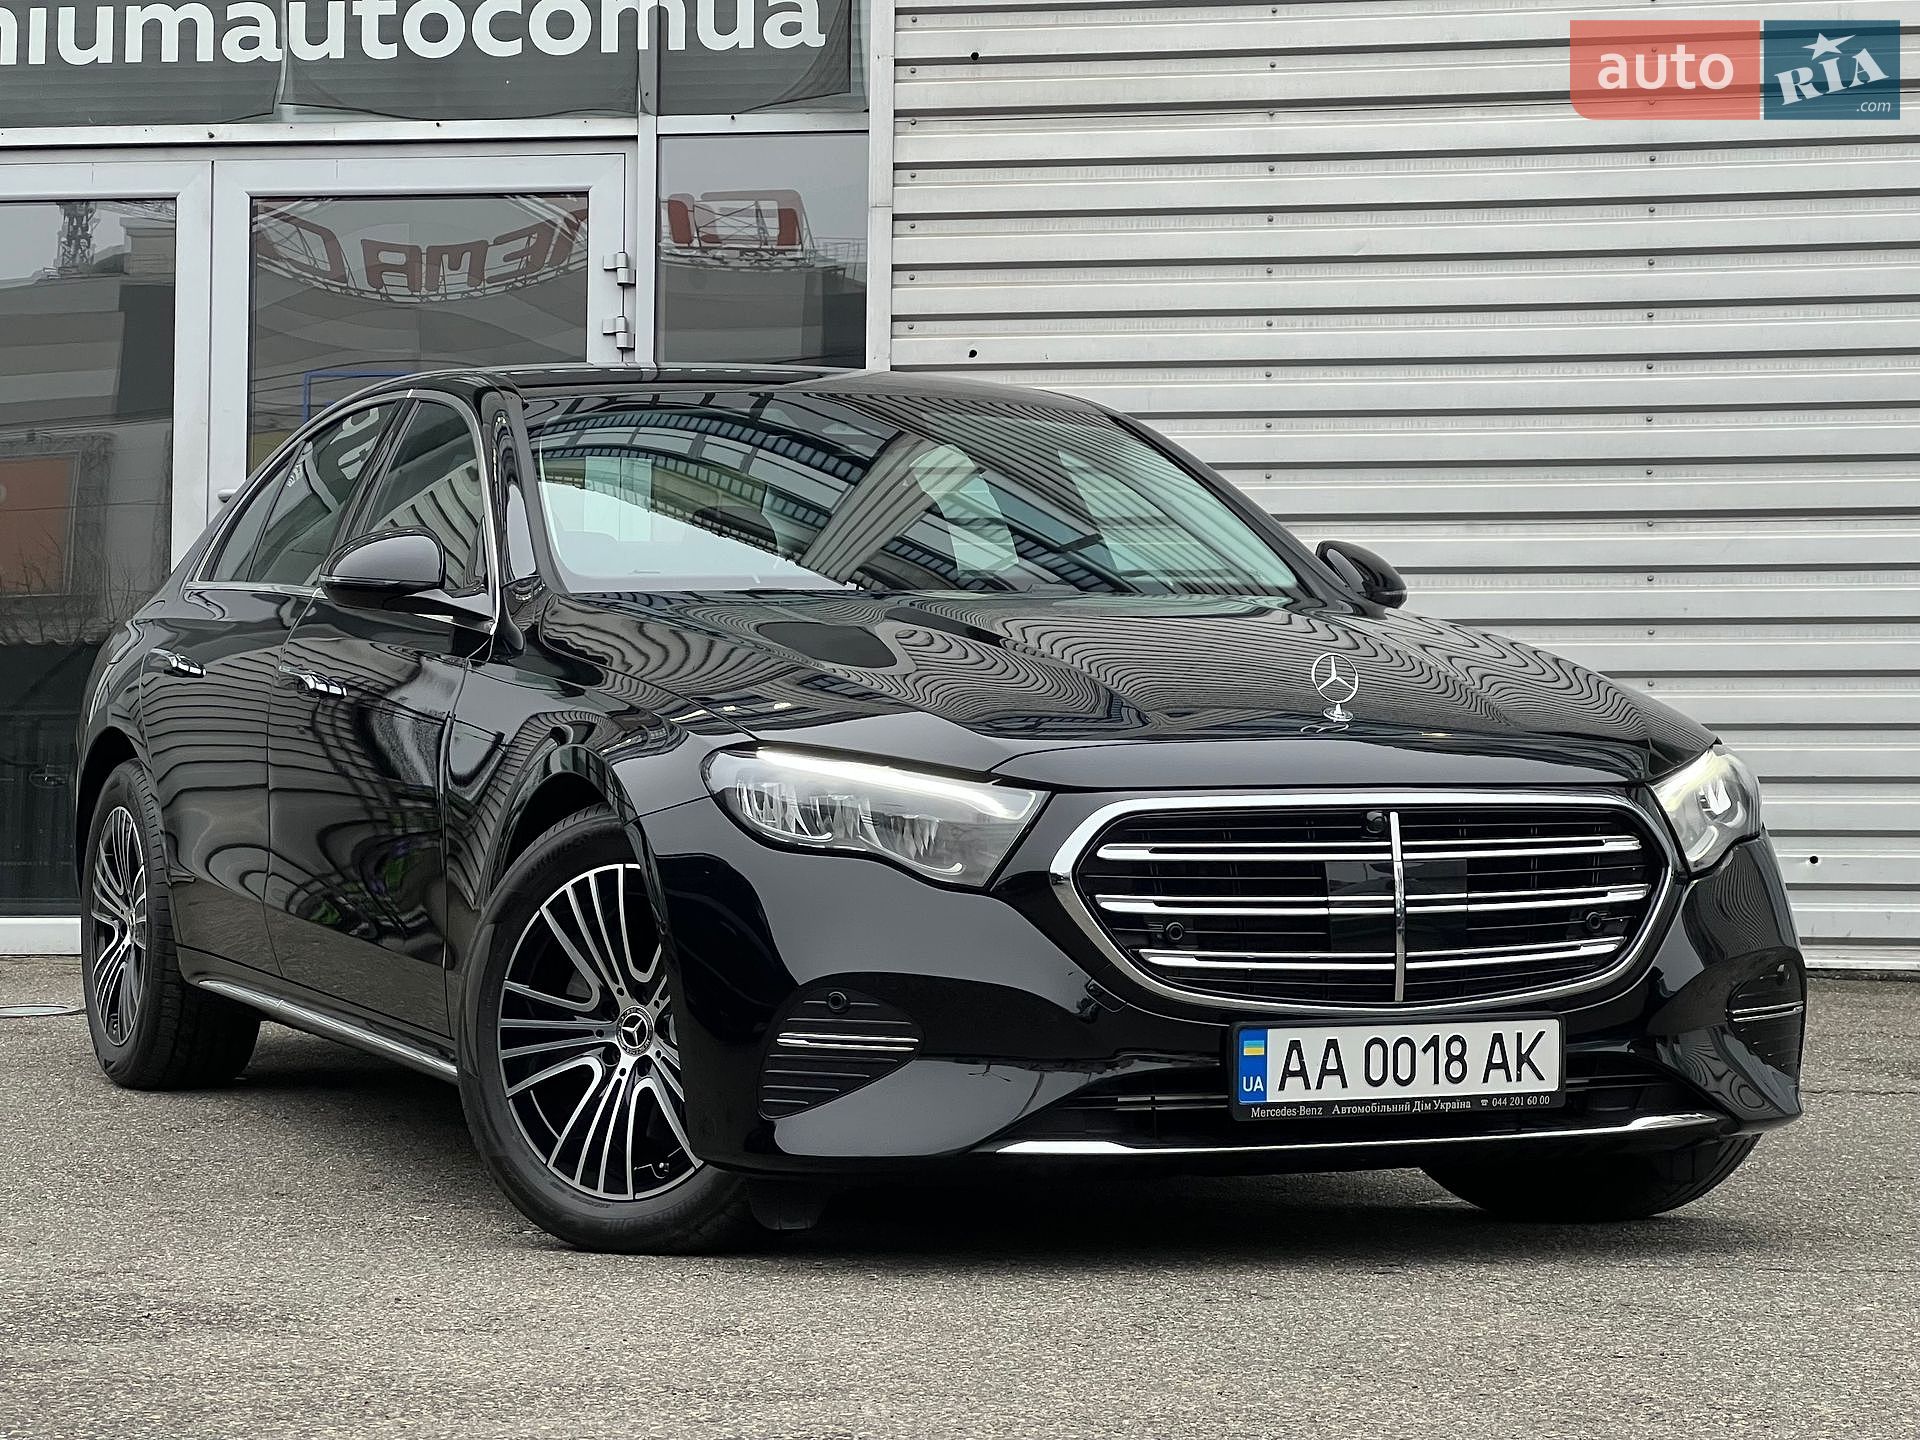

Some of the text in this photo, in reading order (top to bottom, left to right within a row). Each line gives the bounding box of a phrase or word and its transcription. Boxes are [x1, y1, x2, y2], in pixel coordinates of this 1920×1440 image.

[0, 0, 826, 66] iumautocomua
[1277, 1030, 1546, 1092] AA 0018 AK
[1242, 1076, 1264, 1093] UA
[1332, 1099, 1472, 1115] Автомобільний Дім Україна
[1492, 1095, 1550, 1107] 044 201 60 00
[1251, 1105, 1323, 1118] Mercedes-Benz
